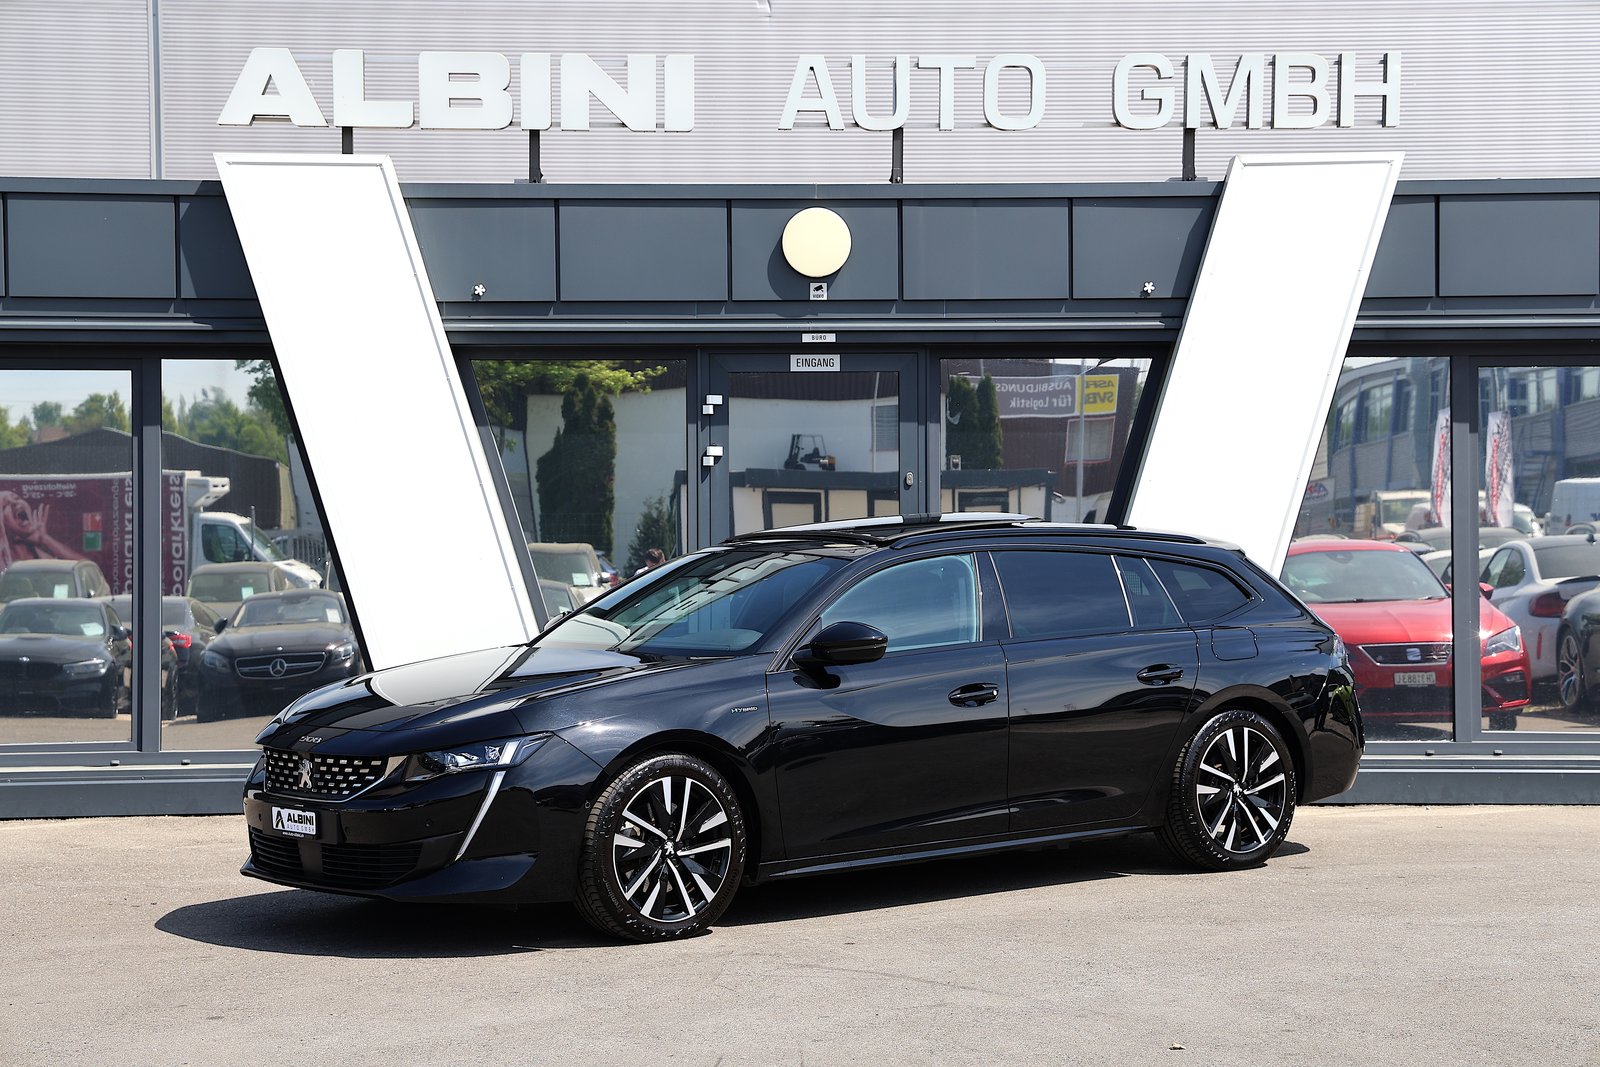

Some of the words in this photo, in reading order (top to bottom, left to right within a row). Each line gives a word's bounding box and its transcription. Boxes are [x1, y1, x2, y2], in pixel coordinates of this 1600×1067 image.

[217, 47, 695, 132] ALBINI
[778, 53, 1047, 131] AUTO
[1113, 52, 1402, 130] GMBH
[796, 358, 835, 368] EINGANG
[299, 735, 322, 743] 508
[287, 812, 314, 826] ALBINI
